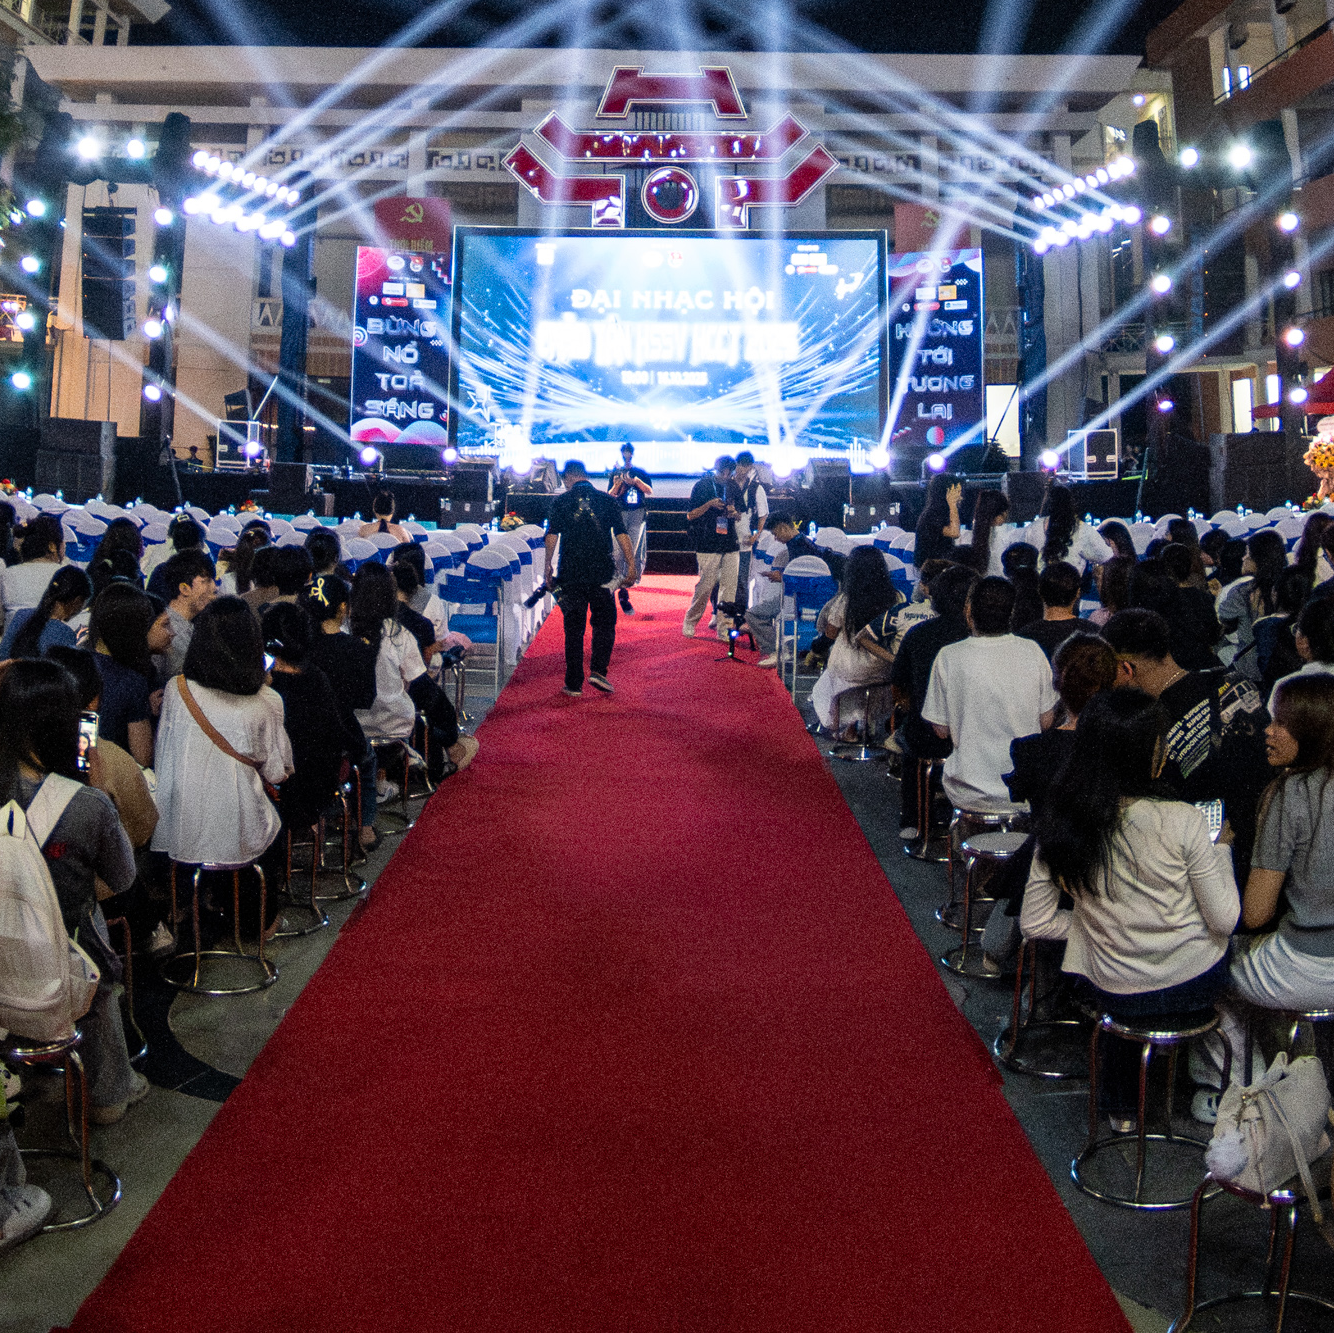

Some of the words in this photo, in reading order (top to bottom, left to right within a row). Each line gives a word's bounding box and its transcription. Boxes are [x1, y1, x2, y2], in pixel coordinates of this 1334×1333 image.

[571, 289, 622, 314] ĐẠI
[632, 290, 714, 315] NHẠC
[723, 286, 775, 315] HỘI
[917, 402, 953, 420] LAI
